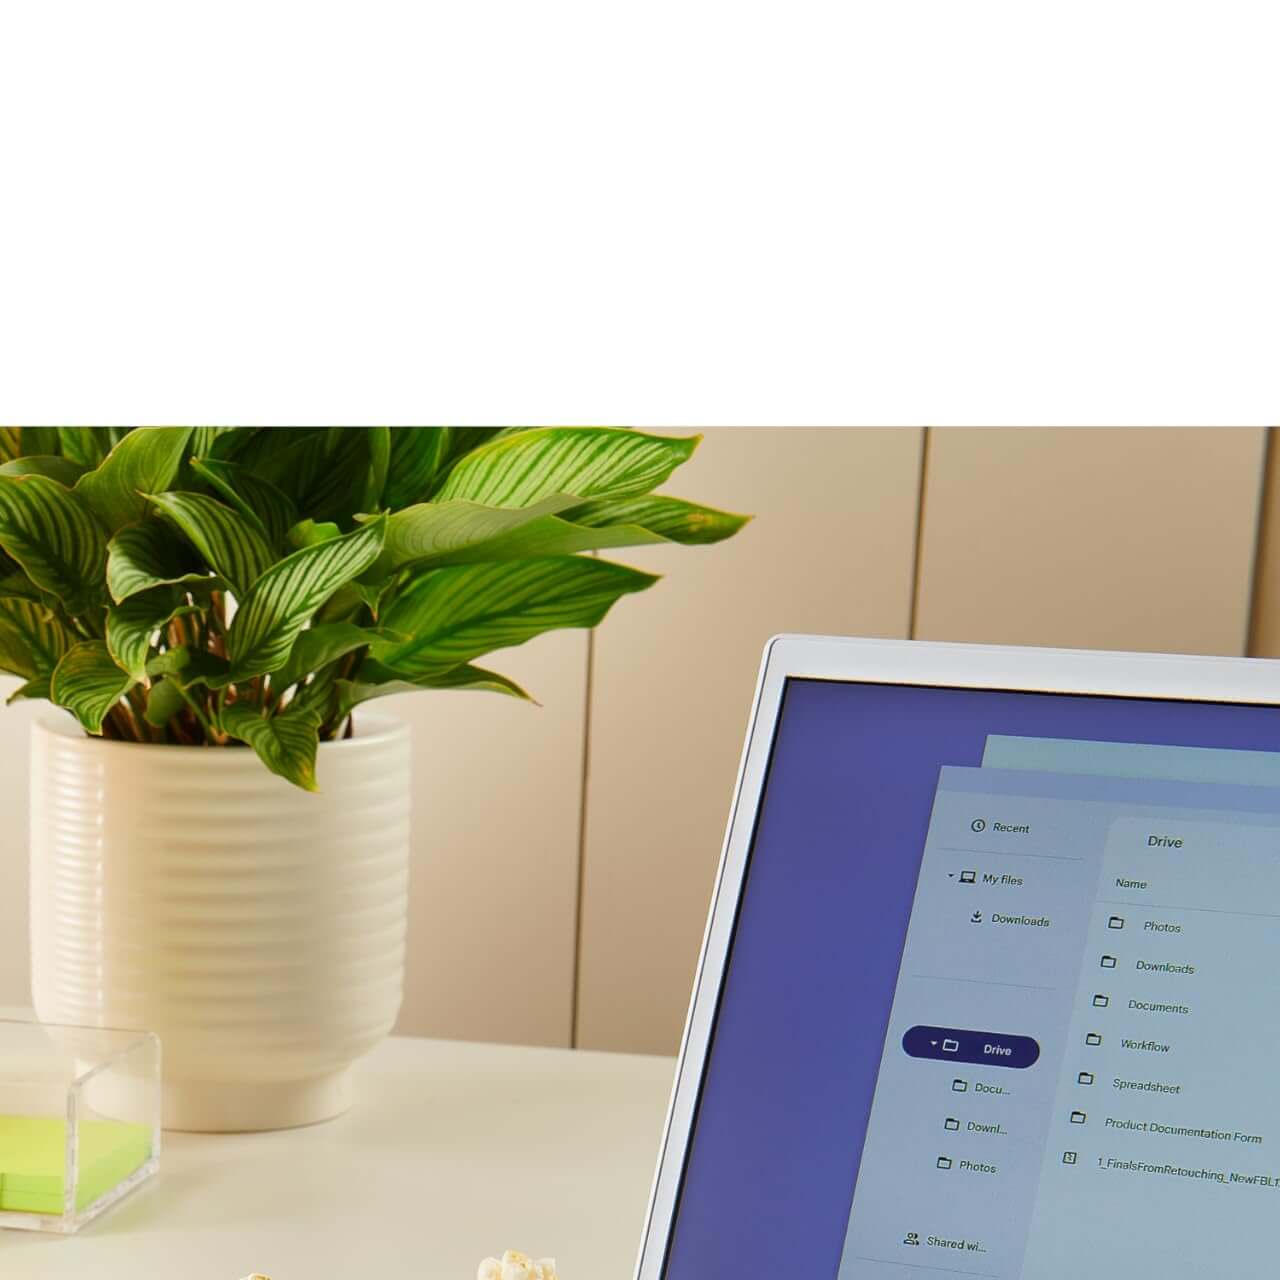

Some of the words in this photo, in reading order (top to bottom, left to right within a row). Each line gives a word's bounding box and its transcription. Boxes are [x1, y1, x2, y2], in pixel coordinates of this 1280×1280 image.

[993, 822, 1030, 835] Recent
[1148, 835, 1183, 849] Drive
[983, 873, 998, 887] My
[1001, 874, 1023, 887] files
[1116, 878, 1147, 890] Name
[991, 914, 1050, 928] Downloads
[1144, 921, 1181, 934] Photos
[1136, 961, 1195, 975] Downloads
[1128, 1000, 1189, 1015] Documents
[984, 1043, 1012, 1056] Drive
[1121, 1039, 1170, 1053] Workflow
[975, 1083, 1011, 1096] Docu...
[1113, 1078, 1181, 1095] Spreadsheet
[967, 1122, 1008, 1135] Downl...
[1105, 1118, 1147, 1132] Product
[1150, 1123, 1231, 1141] Documentation
[1234, 1132, 1263, 1144] Form
[959, 1160, 996, 1173] Photos
[927, 1236, 965, 1250] Shared
